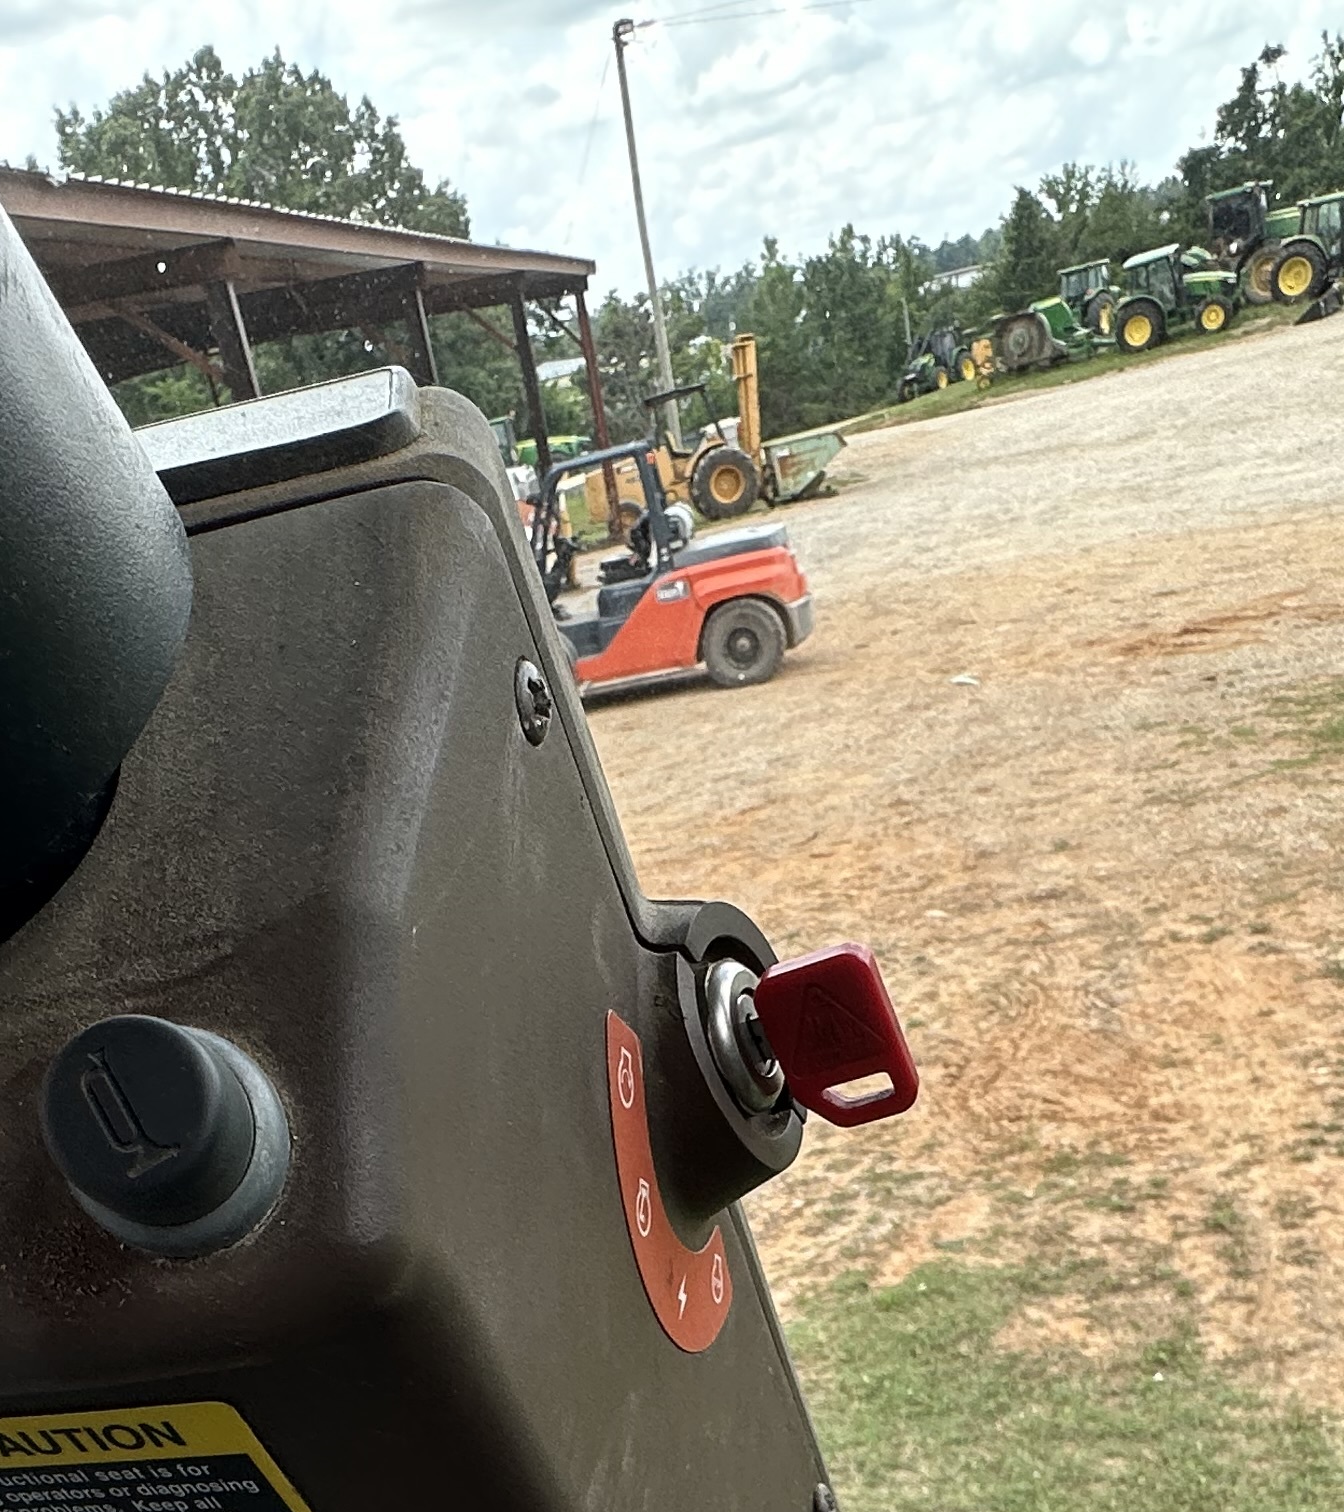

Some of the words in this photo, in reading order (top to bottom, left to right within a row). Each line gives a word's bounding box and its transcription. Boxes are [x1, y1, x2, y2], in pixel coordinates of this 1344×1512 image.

[94, 1466, 146, 1482] seat
[148, 1465, 174, 1479] is
[175, 1463, 210, 1477] for
[5, 1487, 106, 1504] operators
[108, 1486, 133, 1498] or
[136, 1479, 260, 1498] diagnosing
[194, 1496, 224, 1510] all
